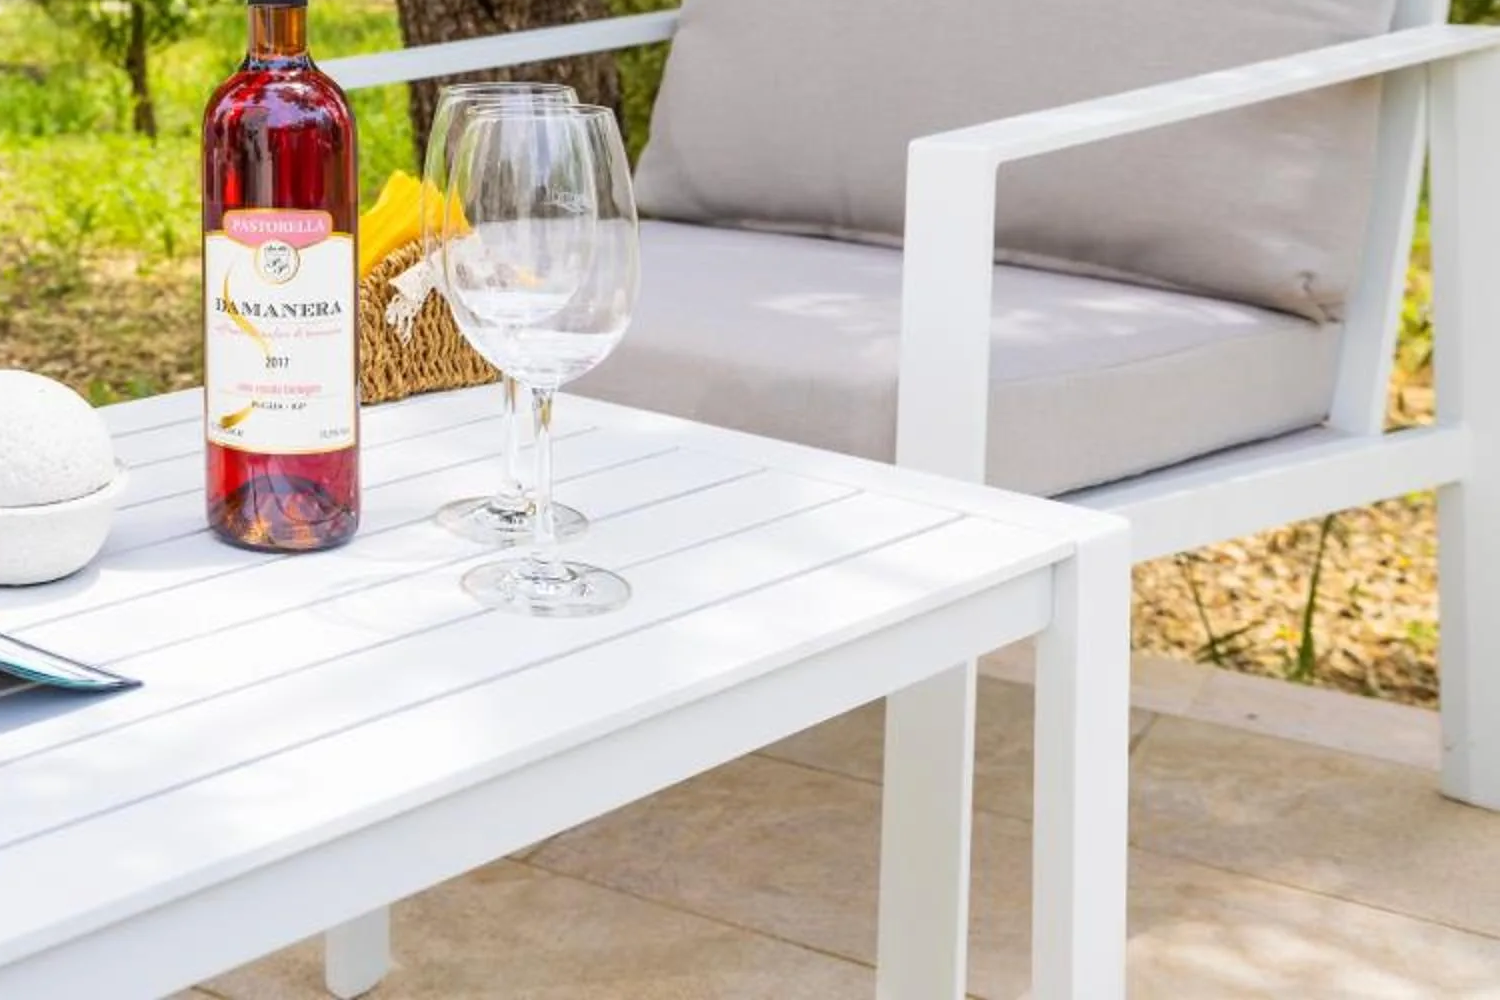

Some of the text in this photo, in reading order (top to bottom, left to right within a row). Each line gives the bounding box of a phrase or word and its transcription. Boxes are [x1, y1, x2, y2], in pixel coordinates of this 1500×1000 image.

[232, 219, 325, 233] PASTORELLA
[215, 297, 342, 318] DAMANERA
[265, 355, 290, 369] 2017
